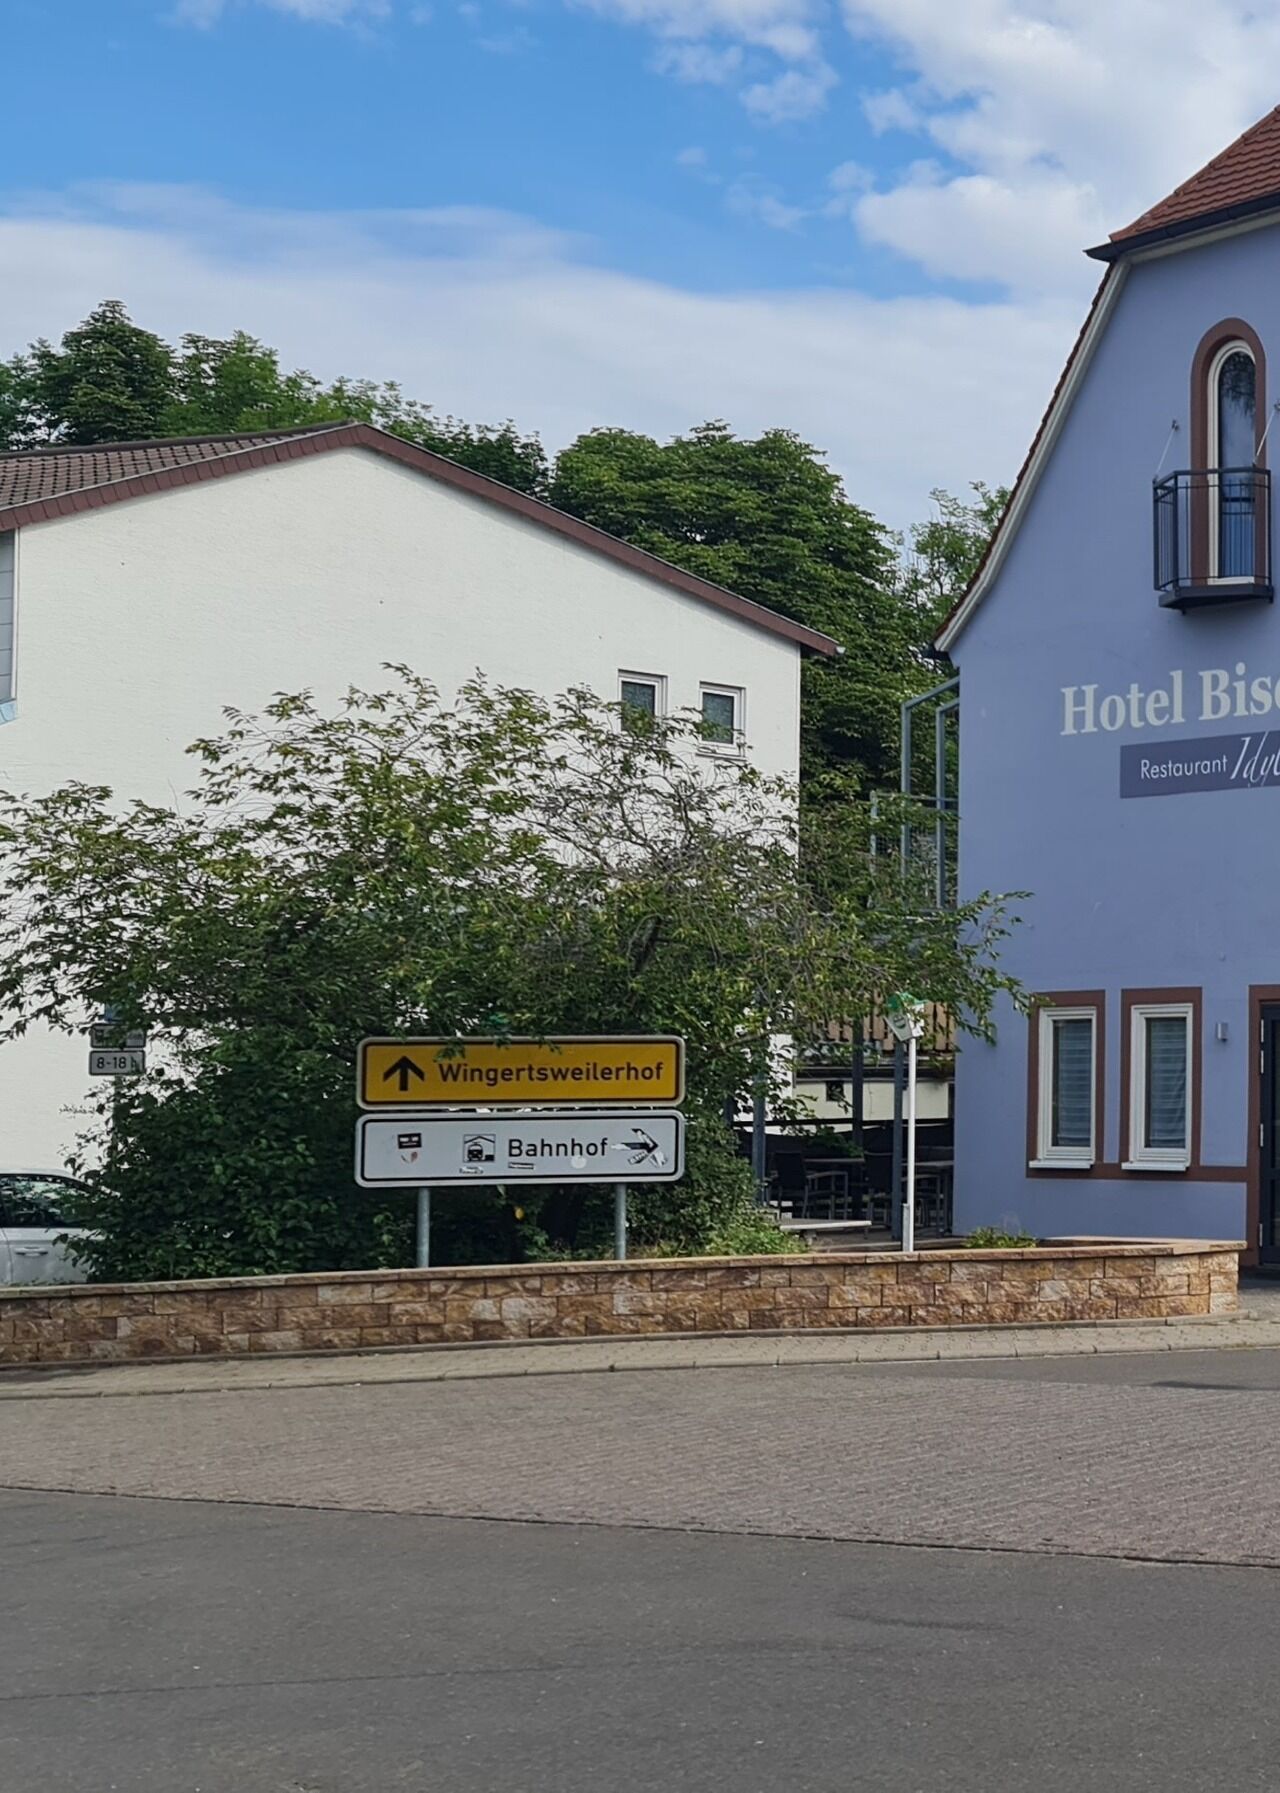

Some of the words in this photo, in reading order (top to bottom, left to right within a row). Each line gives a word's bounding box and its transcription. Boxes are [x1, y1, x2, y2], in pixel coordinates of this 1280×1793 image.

[1060, 670, 1185, 736] Hotel
[1140, 754, 1228, 780] Restaurant
[97, 1057, 127, 1069] 8-18
[439, 1062, 664, 1087] Wingertsweilerhof
[508, 1138, 608, 1158] Bahnhof
